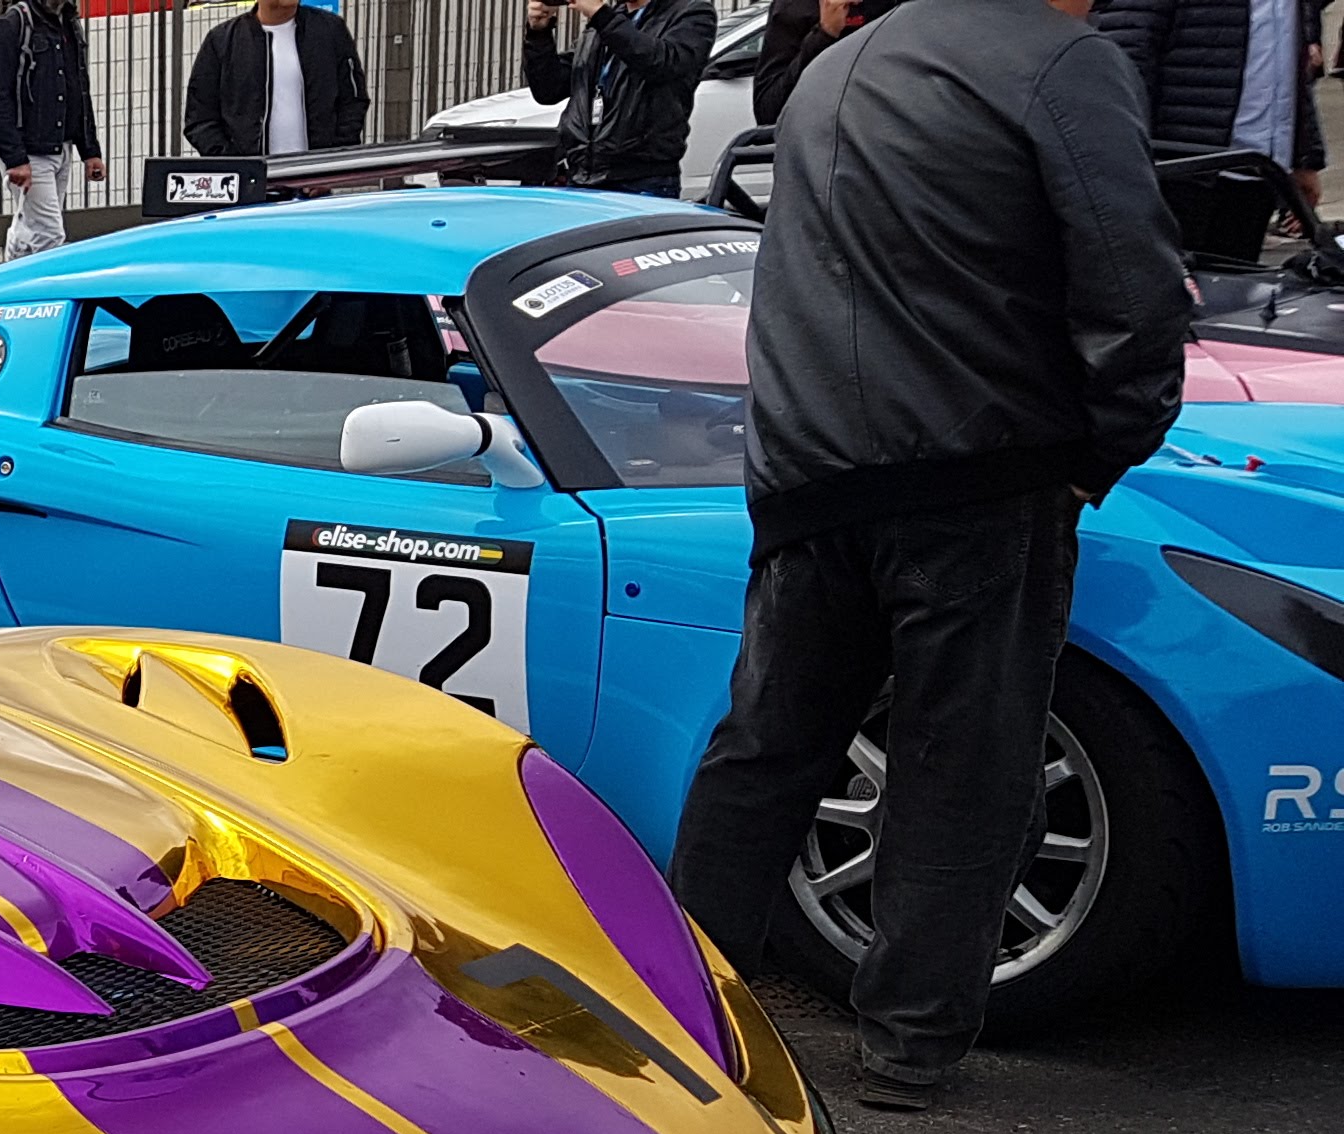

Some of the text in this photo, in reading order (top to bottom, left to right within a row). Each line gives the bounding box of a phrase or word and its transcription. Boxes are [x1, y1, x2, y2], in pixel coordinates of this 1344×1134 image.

[634, 245, 710, 270] AVON
[539, 279, 576, 298] LOTUS
[4, 305, 62, 320] D.PLANT
[318, 526, 480, 560] elise-shop.com
[316, 562, 496, 718] 72
[1261, 822, 1291, 833] ROB
